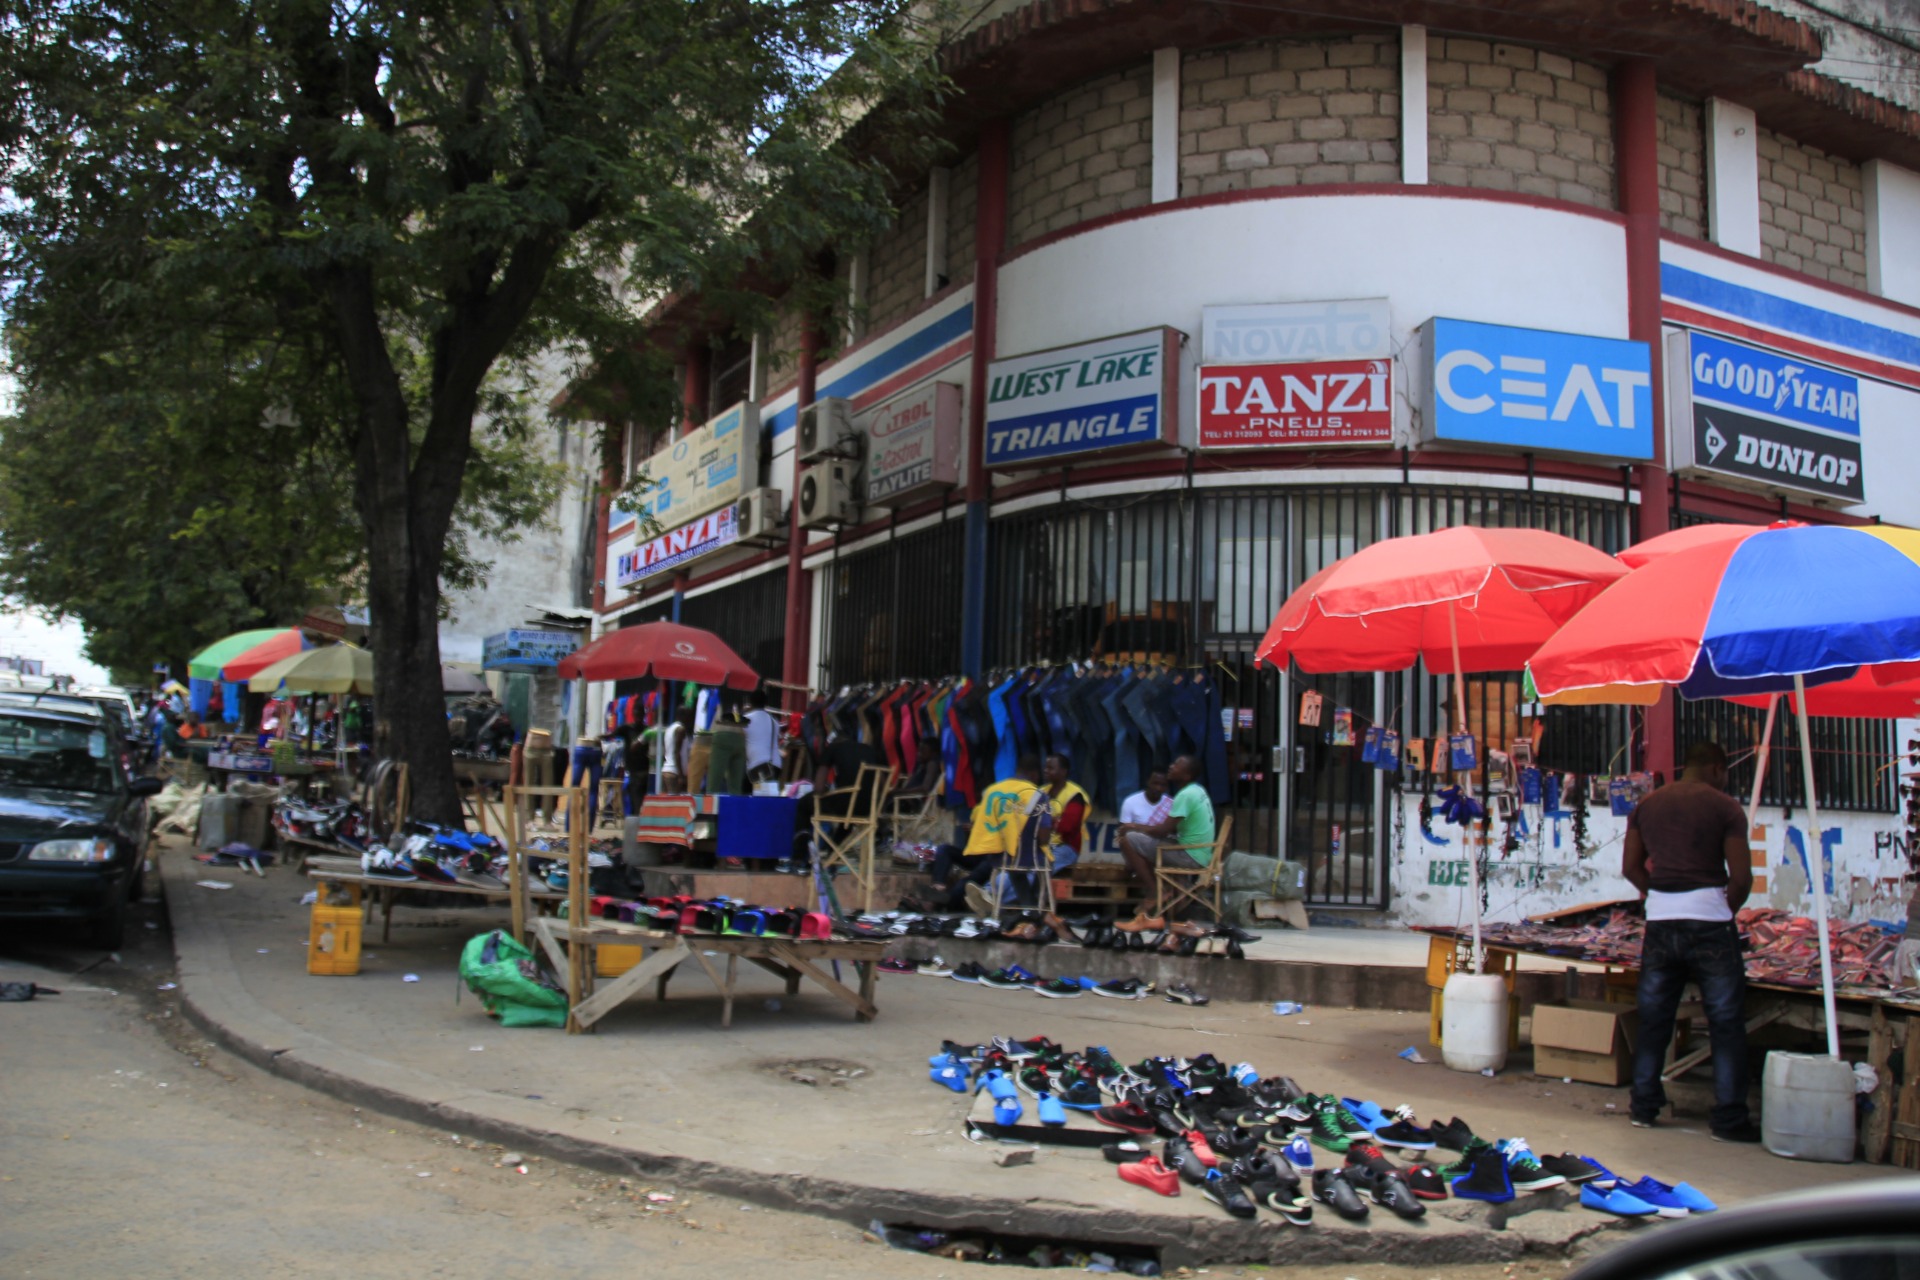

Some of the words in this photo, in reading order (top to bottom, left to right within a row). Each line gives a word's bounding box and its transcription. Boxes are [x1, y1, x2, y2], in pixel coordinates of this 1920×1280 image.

[989, 368, 1071, 404] WEST
[1076, 352, 1158, 388] LAKE
[1201, 371, 1389, 415] TANZI
[1435, 349, 1650, 429] CEAT
[991, 406, 1154, 454] TRIANGLE
[869, 462, 932, 499] RAYLITE
[1734, 434, 1858, 486] DUNLOP
[631, 515, 719, 572] TANZI
